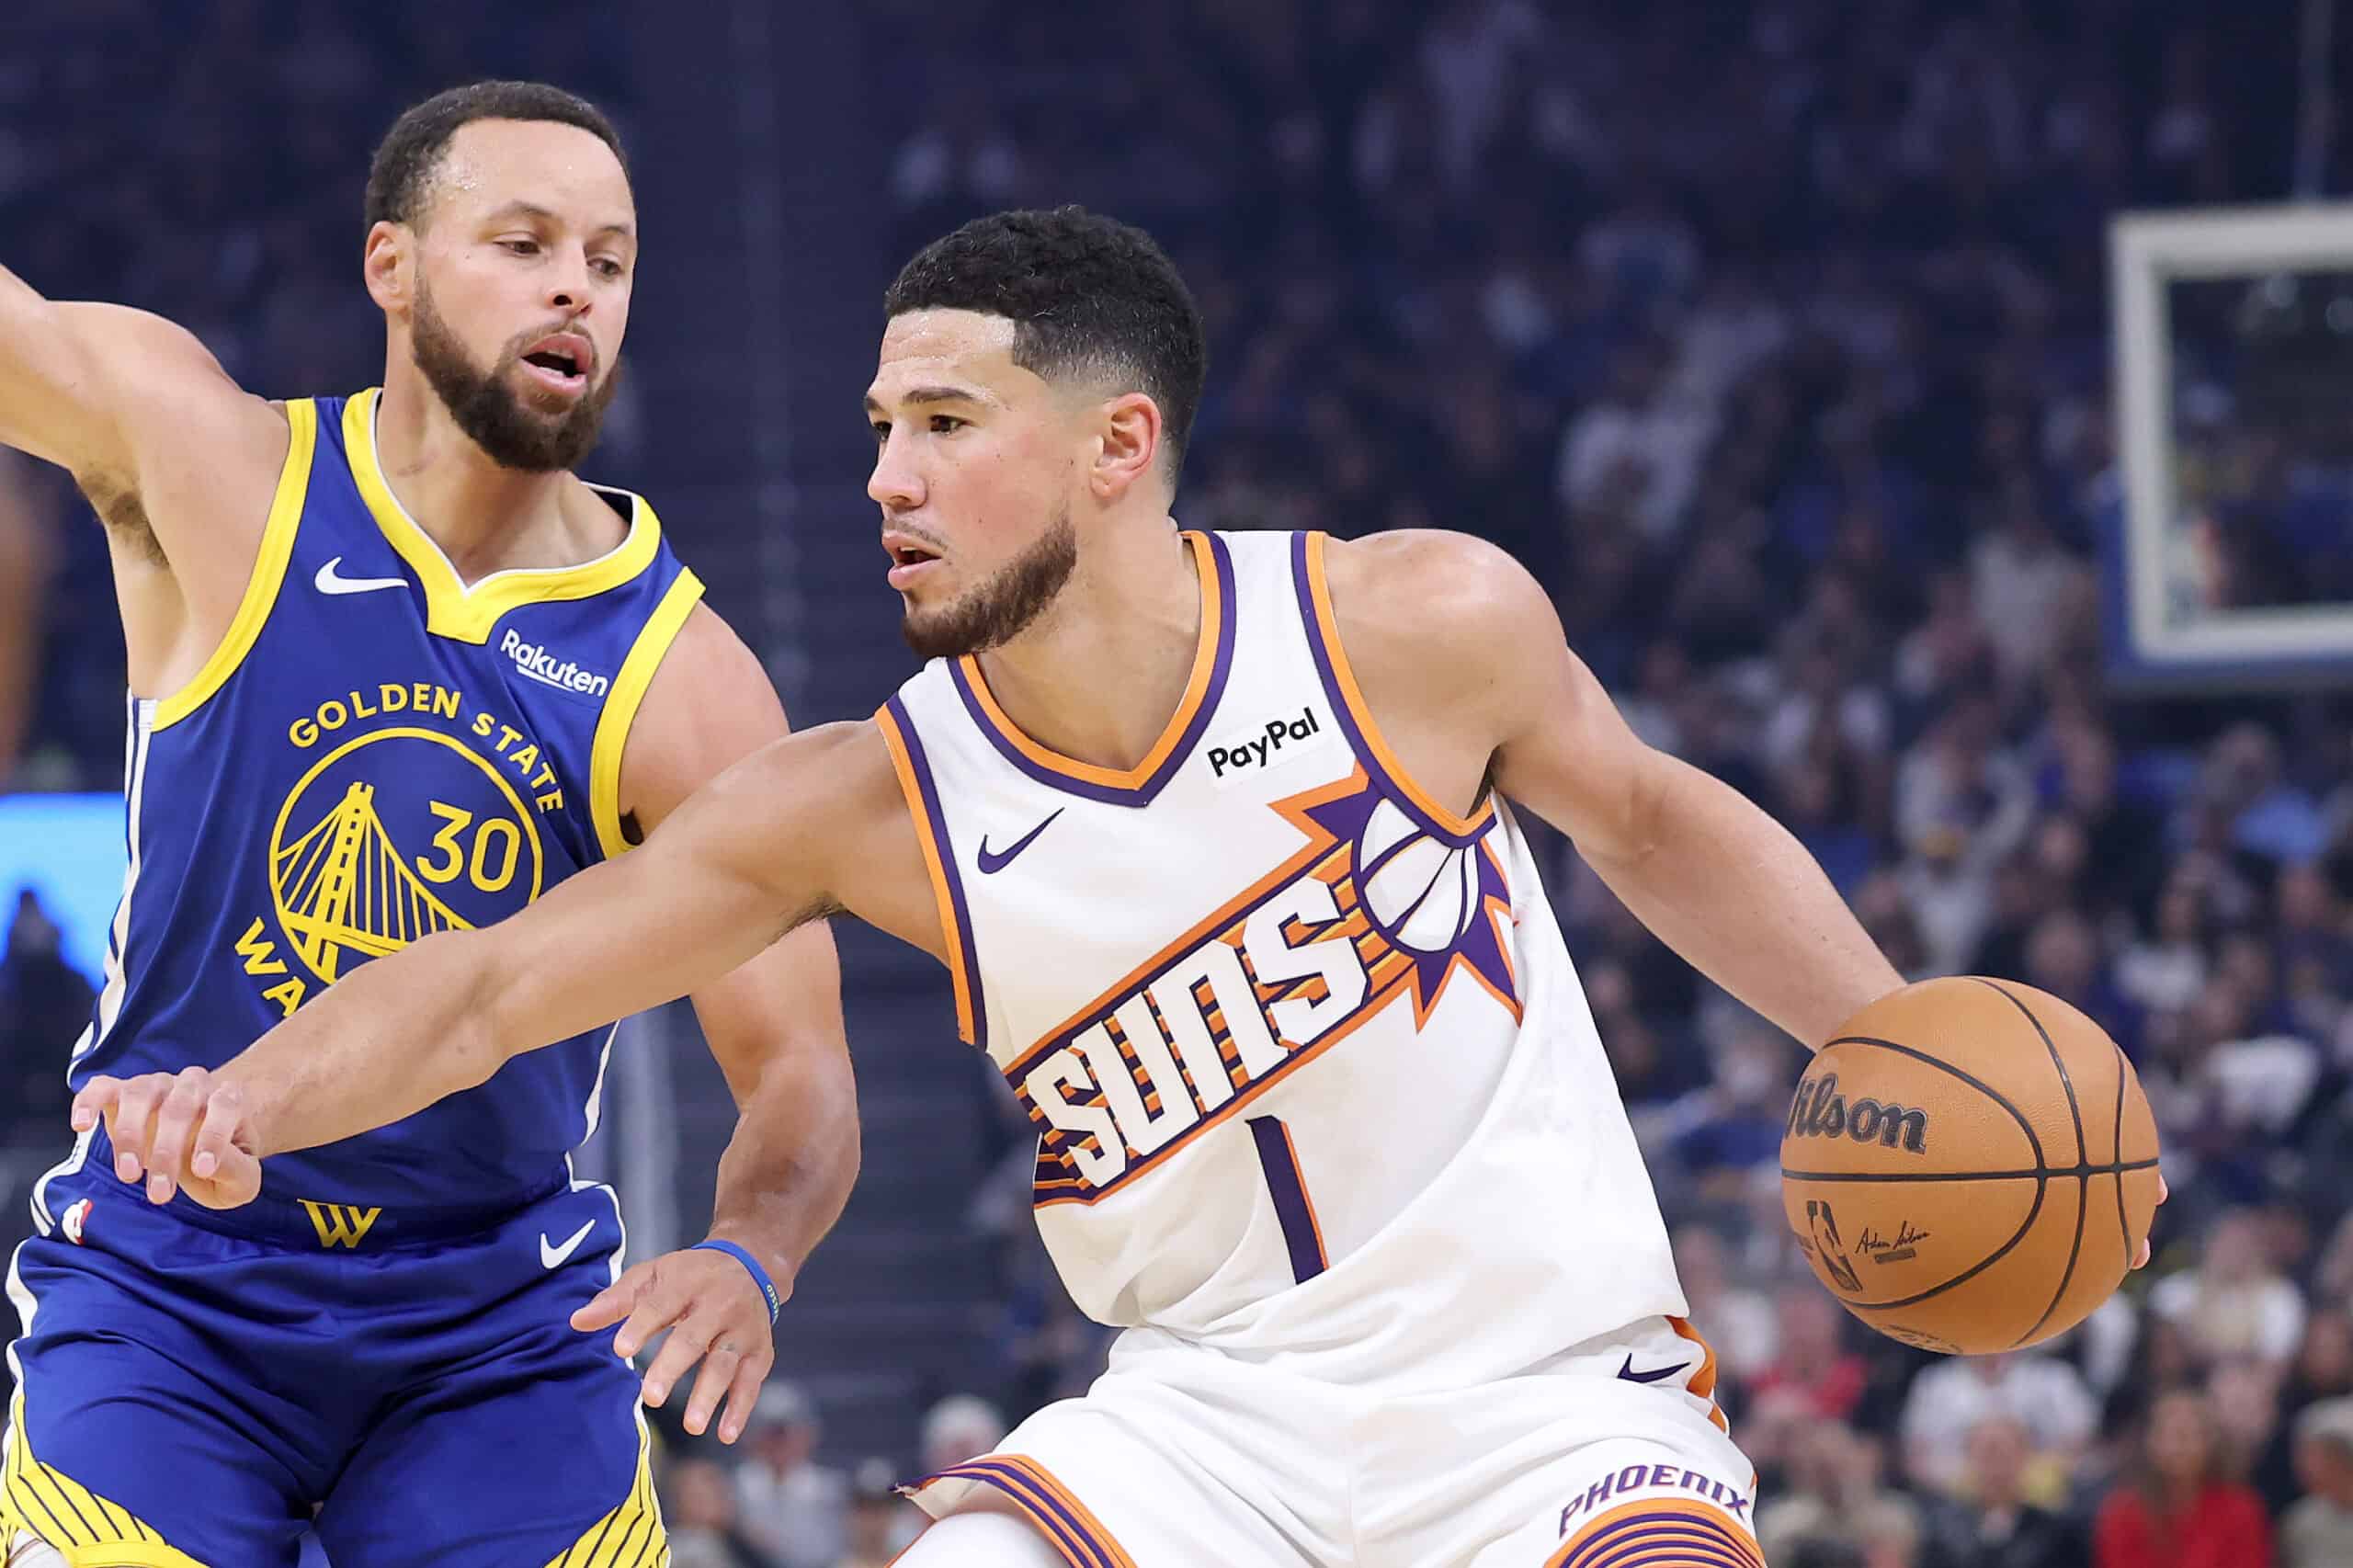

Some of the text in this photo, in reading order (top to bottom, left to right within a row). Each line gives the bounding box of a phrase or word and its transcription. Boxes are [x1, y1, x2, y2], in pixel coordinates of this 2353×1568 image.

[501, 629, 608, 697] Rakuten
[289, 683, 563, 814] GOLDEN STATE
[1207, 708, 1320, 777] PayPal
[416, 801, 521, 892] 30
[1025, 875, 1369, 1188] SUNS
[1245, 1115, 1330, 1285] 1
[1559, 1463, 1749, 1540] PHOENIX
